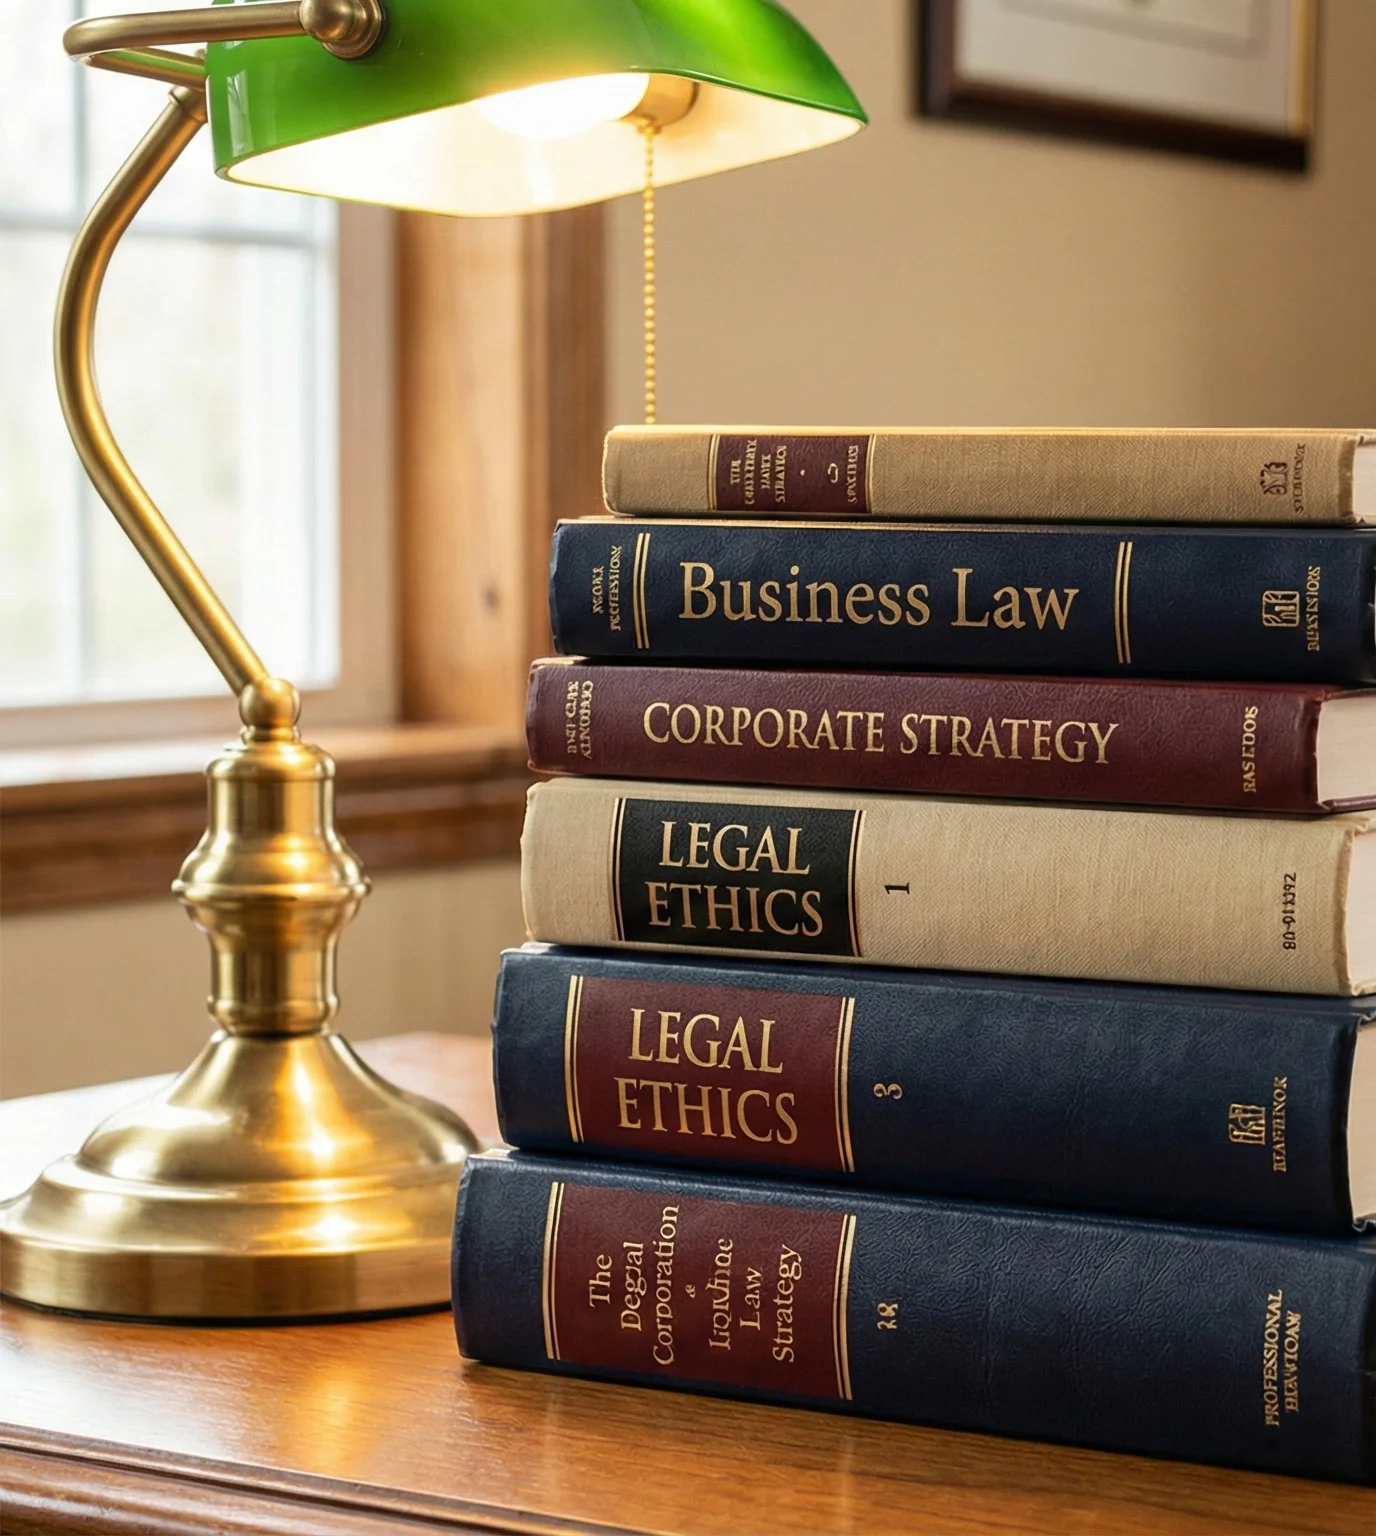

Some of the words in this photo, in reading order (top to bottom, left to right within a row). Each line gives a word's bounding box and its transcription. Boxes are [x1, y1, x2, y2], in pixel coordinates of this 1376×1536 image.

[678, 561, 931, 624] Business
[951, 567, 1080, 631] Law
[643, 701, 885, 752] CORPORATE
[900, 712, 1119, 765] STRATEGY
[659, 820, 811, 875] LEGAL
[645, 881, 824, 937] ETHICS
[884, 882, 910, 895] 1
[628, 1007, 783, 1074] LEGAL
[614, 1076, 799, 1145] ETHICS
[873, 1083, 903, 1100] 3
[589, 1253, 613, 1308] The
[652, 1204, 680, 1366] Corporation
[740, 1267, 763, 1331] Law
[772, 1243, 802, 1363] Strategy
[1263, 1288, 1283, 1428] PROFESSIONAL
